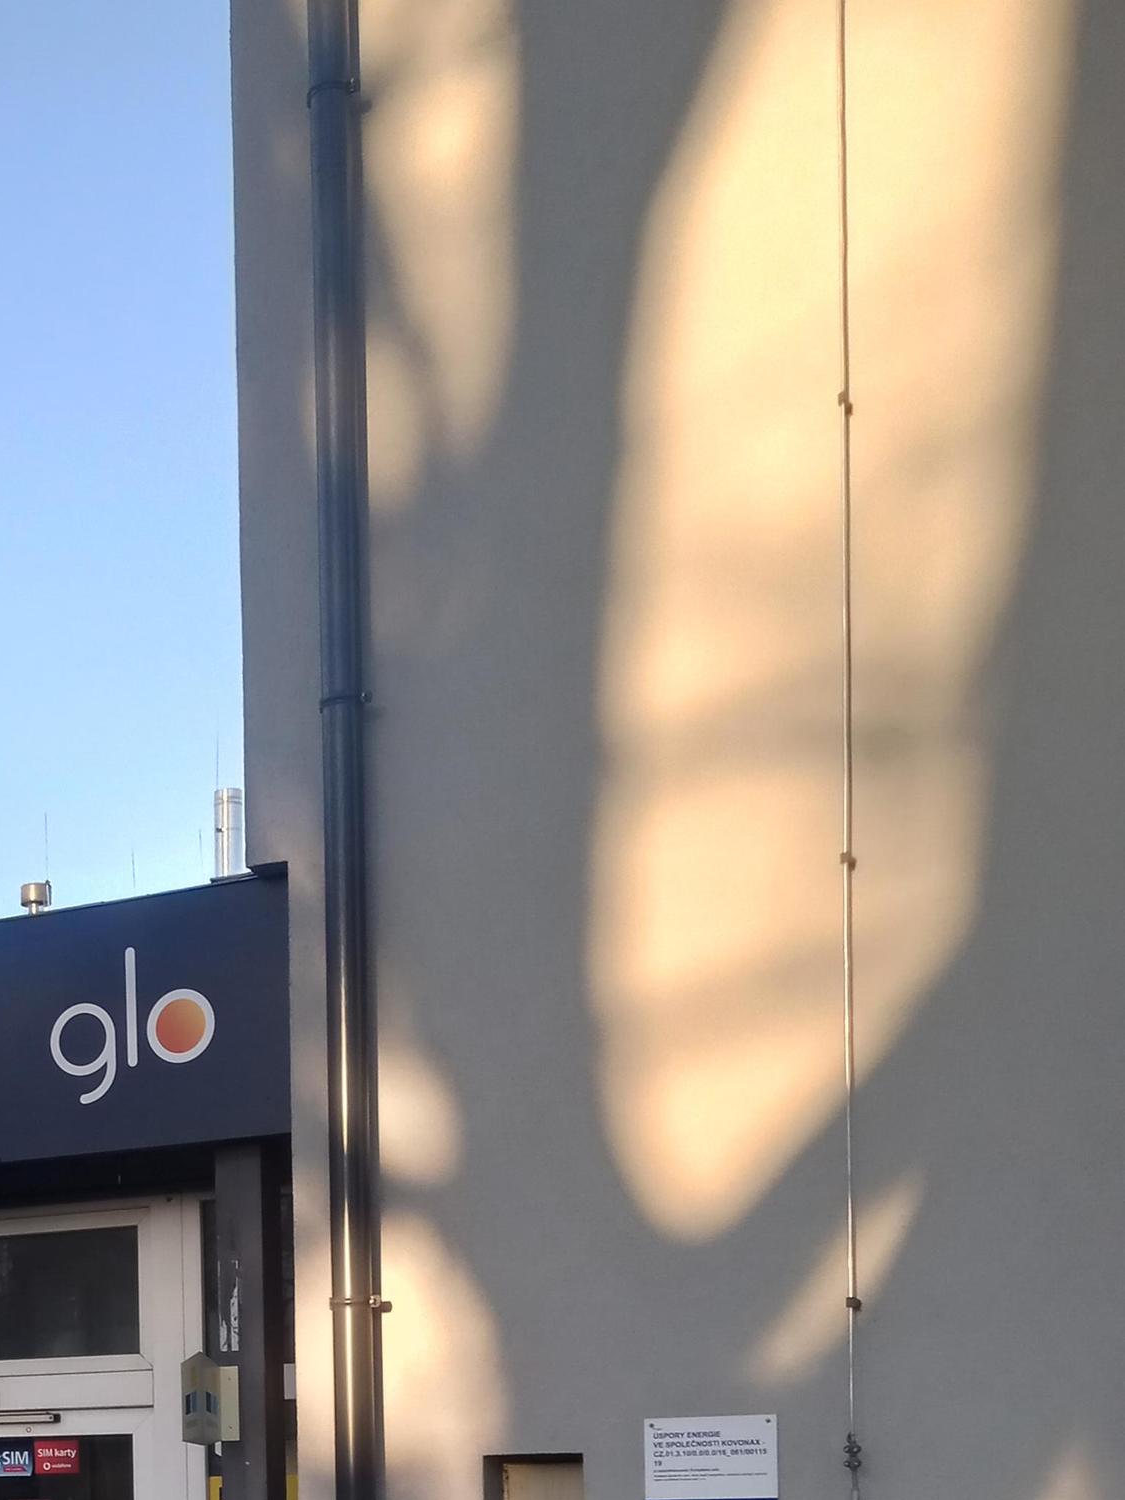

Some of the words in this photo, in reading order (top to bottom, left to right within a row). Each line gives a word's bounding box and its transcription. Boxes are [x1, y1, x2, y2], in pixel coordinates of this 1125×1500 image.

[50, 946, 215, 1105] glo
[686, 1430, 721, 1438] ENERGIE
[665, 1439, 720, 1448] SPOLEČNOSTI
[721, 1439, 760, 1447] KOVONAX
[37, 1449, 54, 1458] SIM
[55, 1448, 77, 1459] karty
